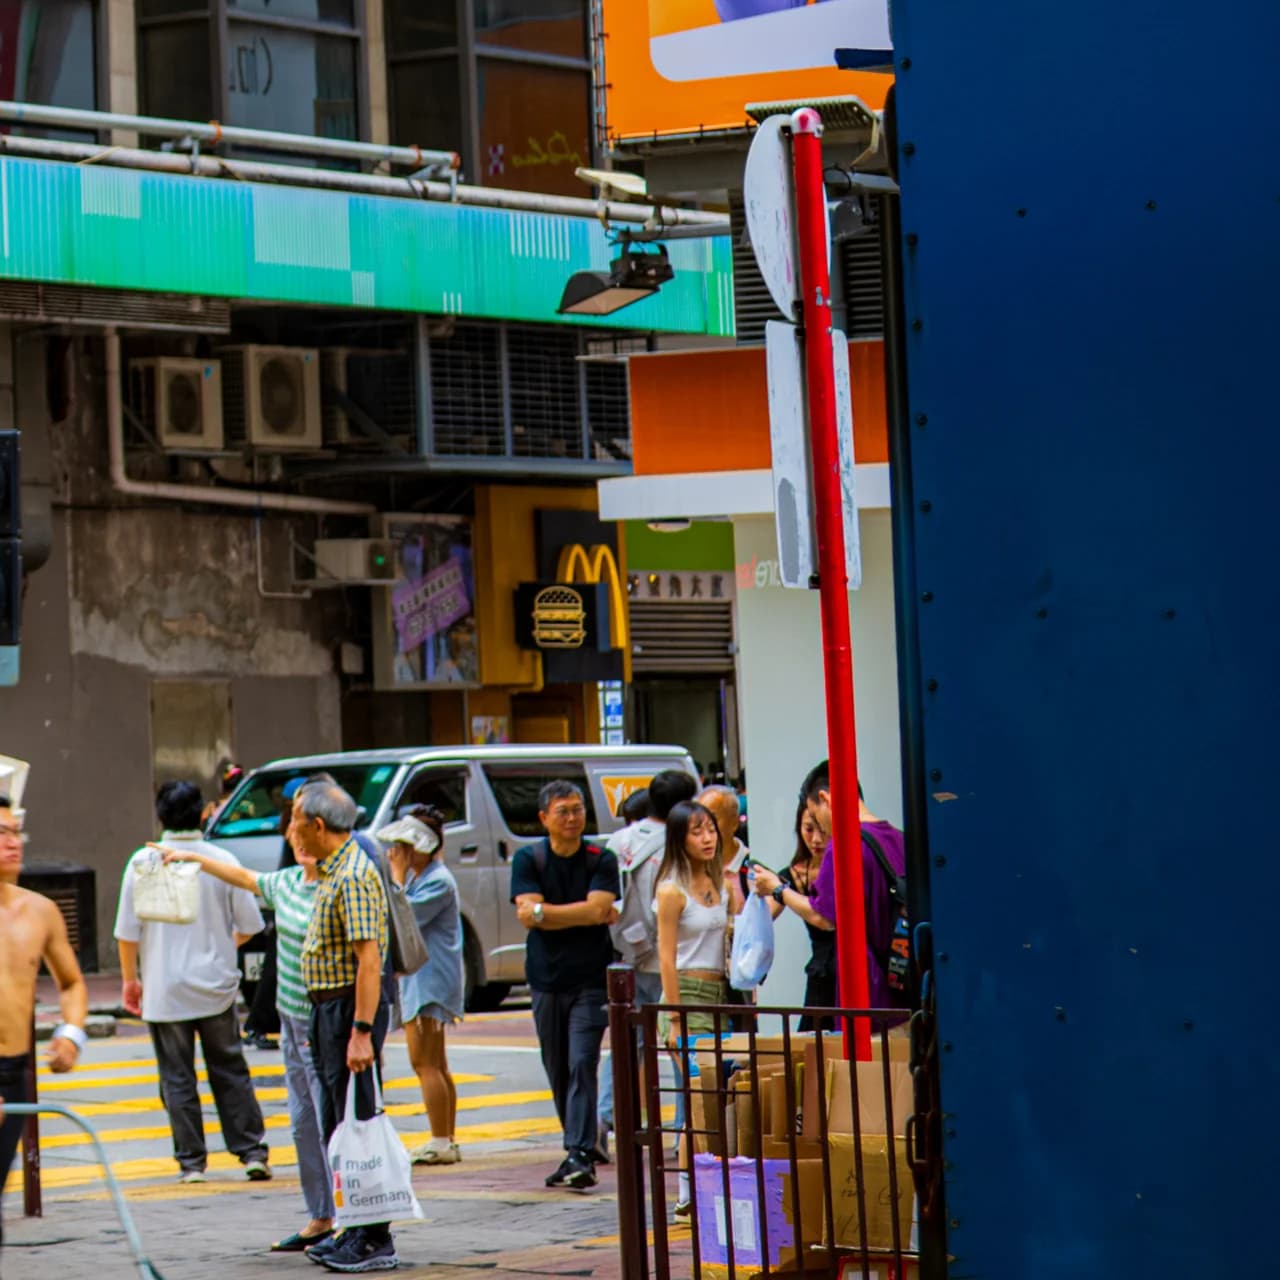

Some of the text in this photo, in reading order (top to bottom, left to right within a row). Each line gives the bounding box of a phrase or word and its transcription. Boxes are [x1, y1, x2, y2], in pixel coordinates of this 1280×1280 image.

[345, 1155, 384, 1171] made
[347, 1175, 361, 1189] in
[349, 1189, 412, 1208] Germany
